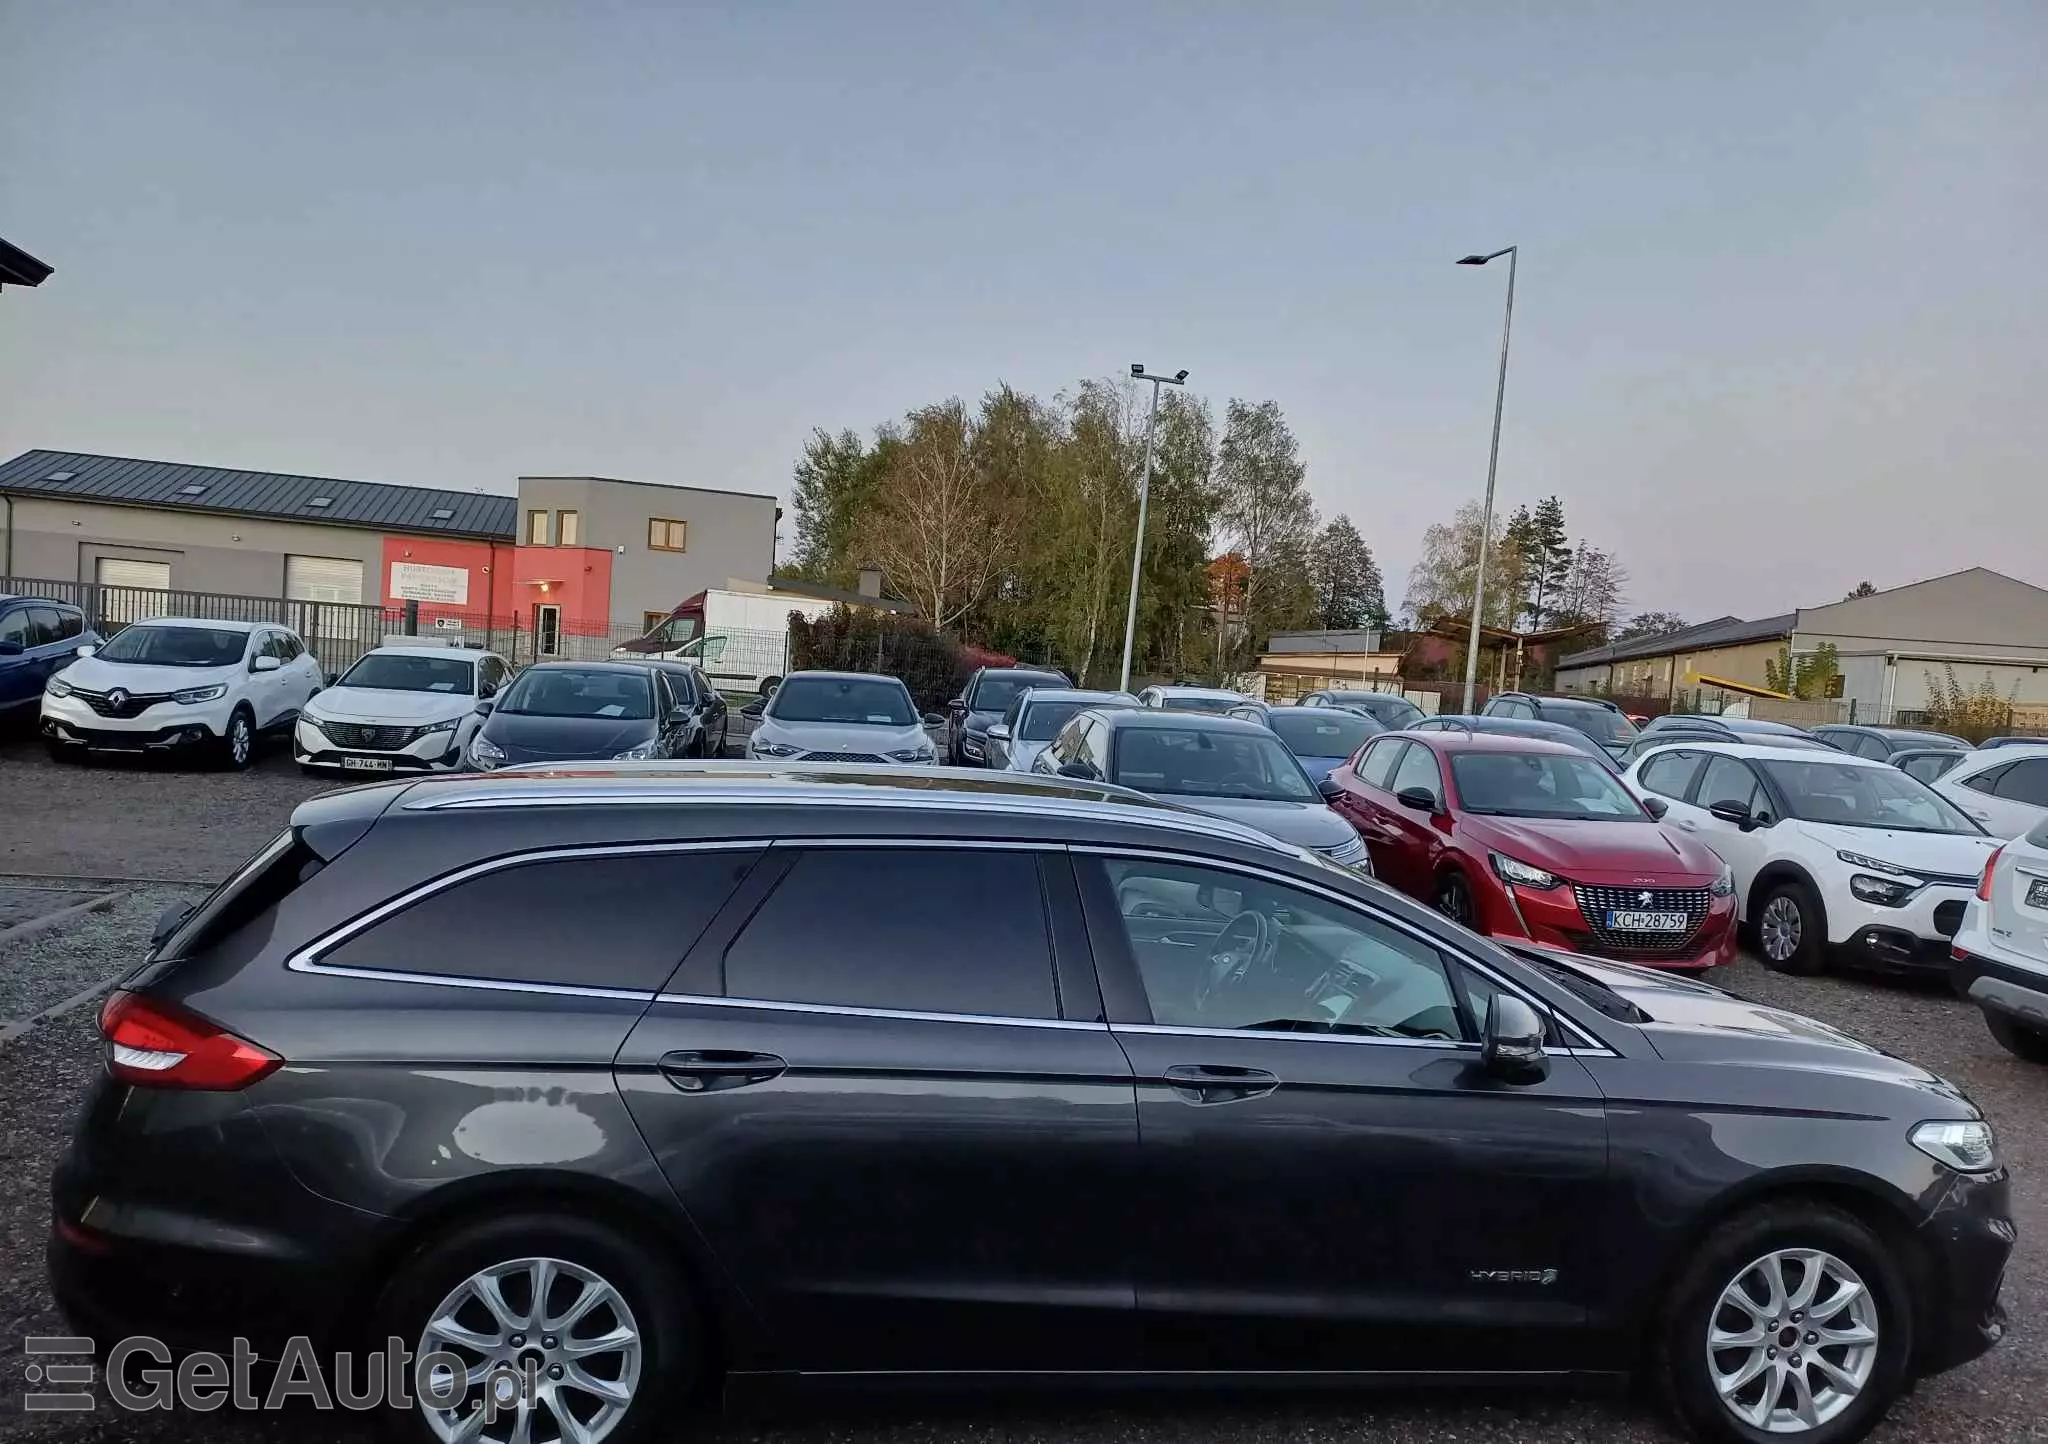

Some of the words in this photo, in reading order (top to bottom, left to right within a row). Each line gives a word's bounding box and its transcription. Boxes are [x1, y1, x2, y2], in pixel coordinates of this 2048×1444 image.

[1613, 912, 1641, 928] KCH
[1645, 913, 1685, 929] 28759
[1470, 1270, 1541, 1282] HYBRID
